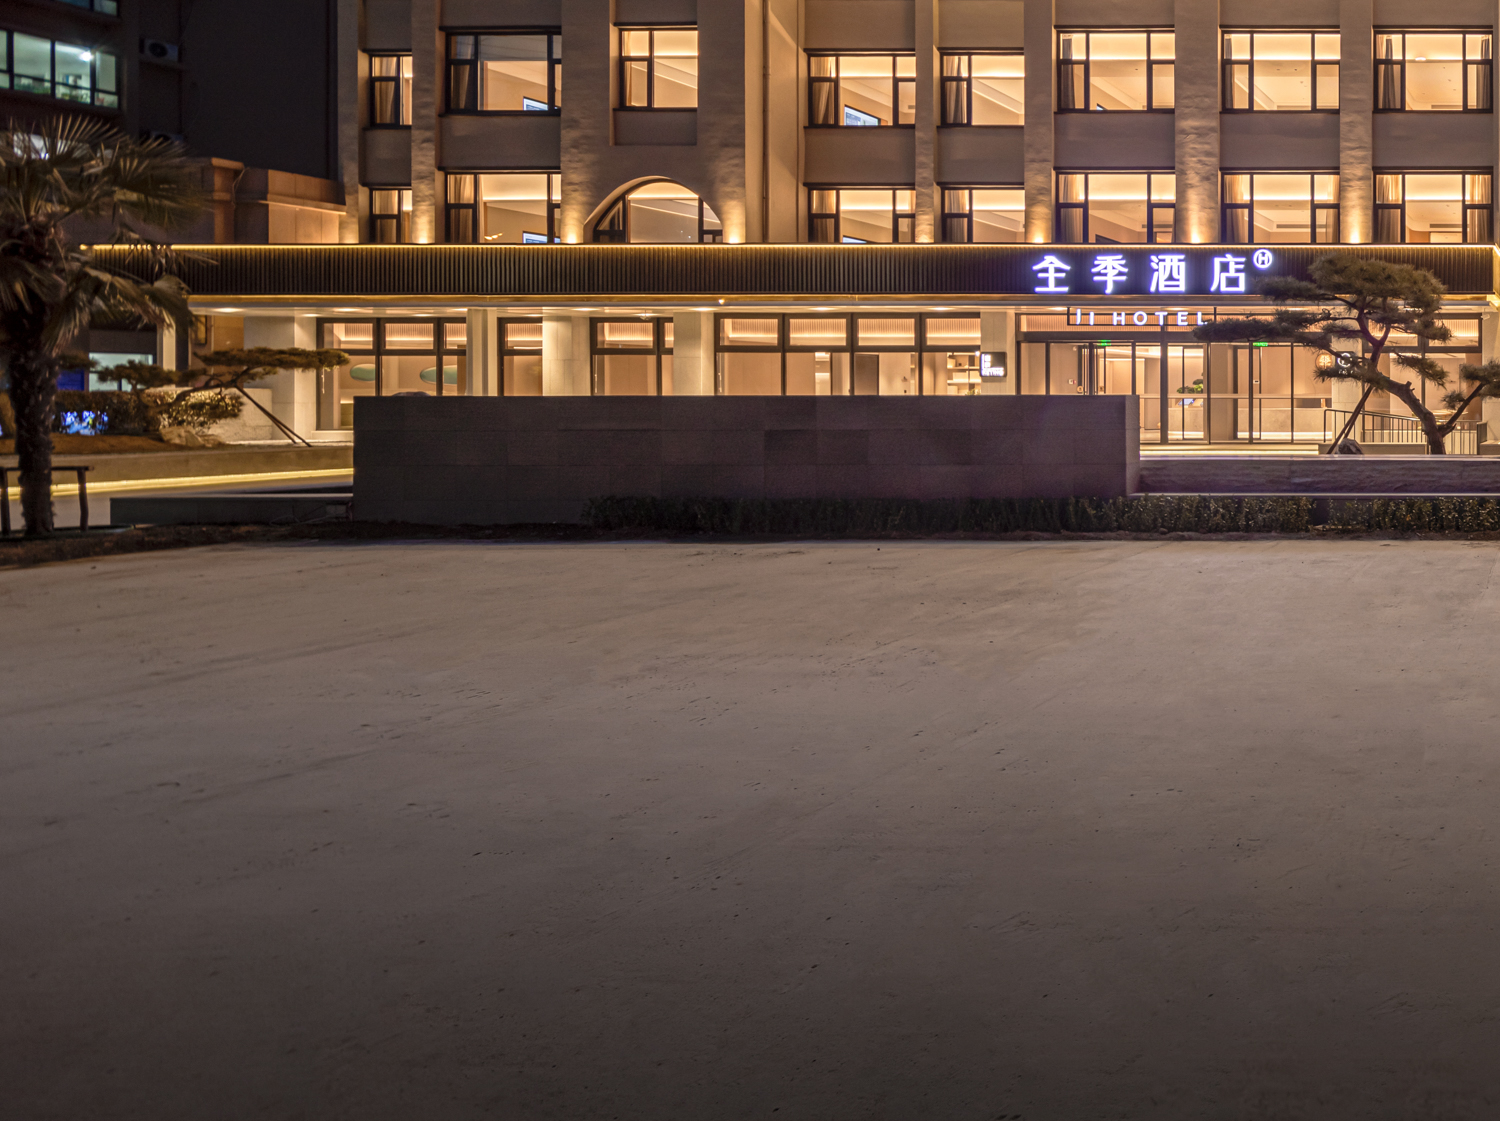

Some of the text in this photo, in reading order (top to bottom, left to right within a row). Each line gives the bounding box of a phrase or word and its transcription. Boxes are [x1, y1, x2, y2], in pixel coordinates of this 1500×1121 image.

[1032, 254, 1246, 294] 全季酒店
[1076, 308, 1208, 326] JI HOTEL
